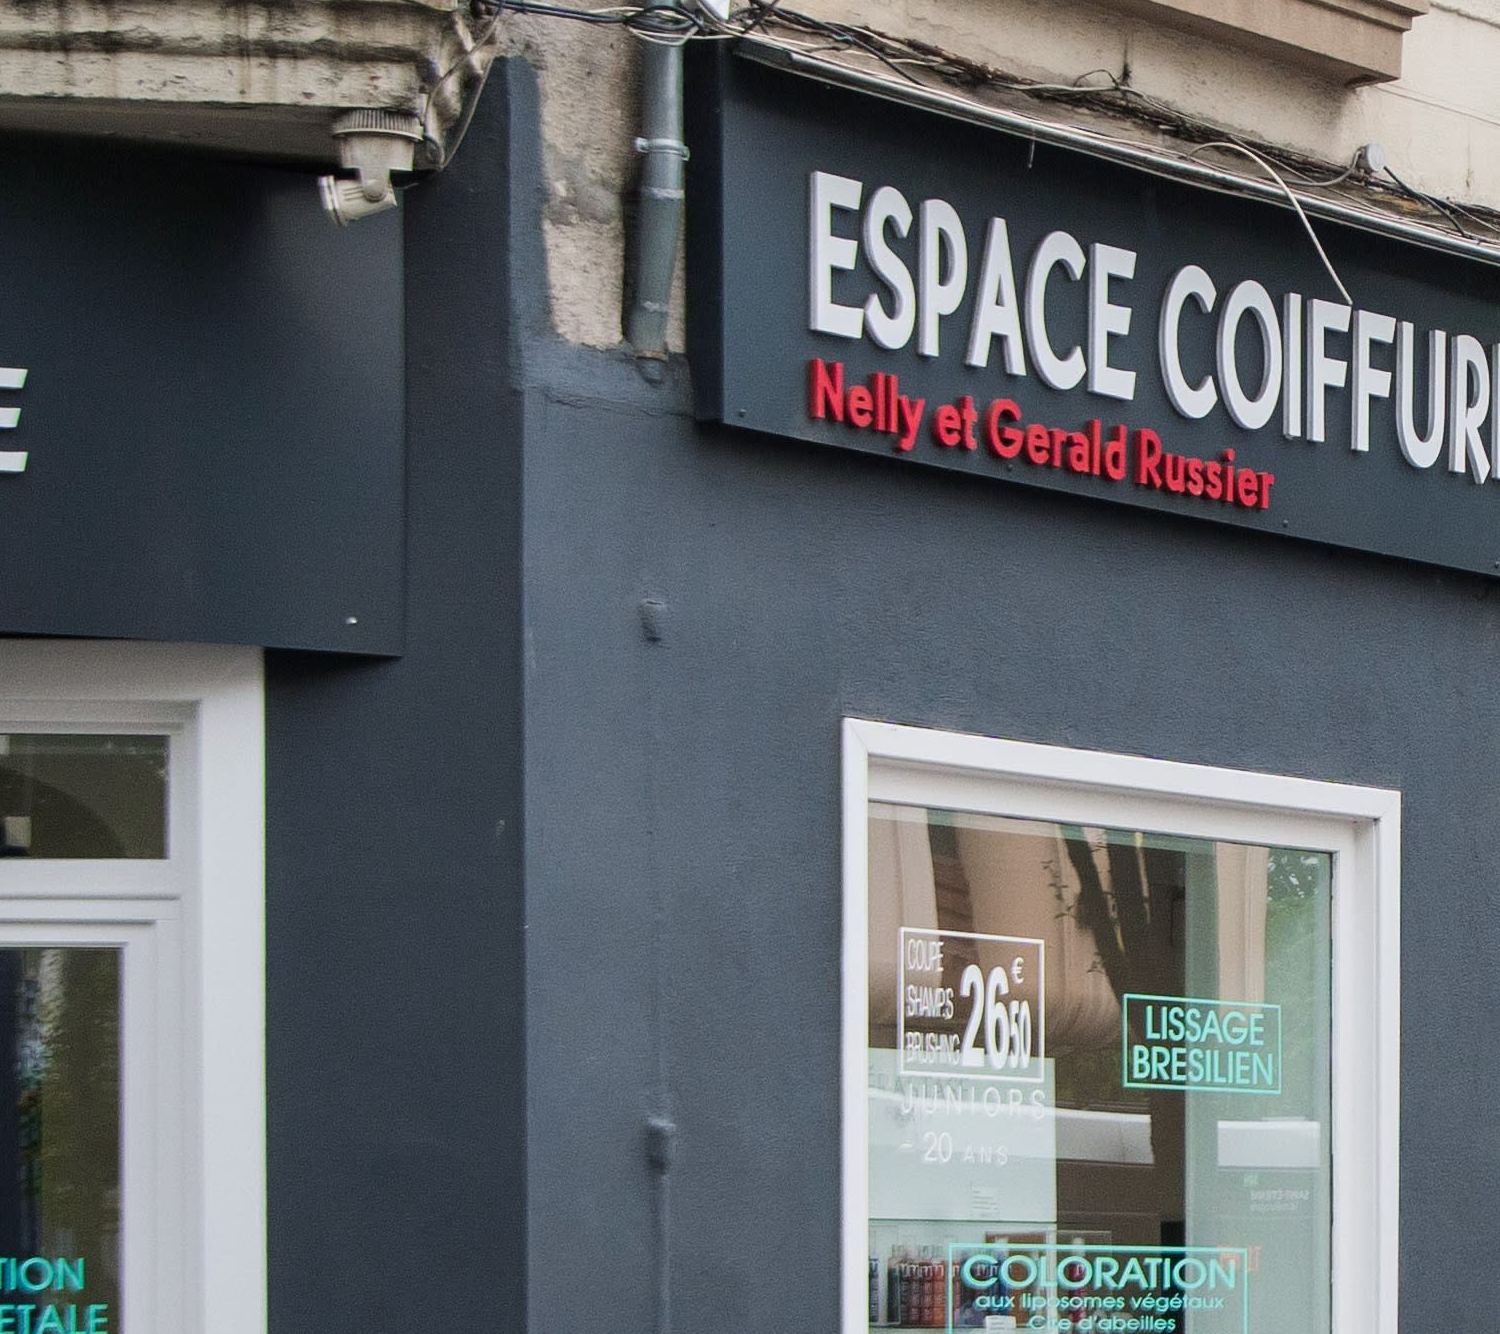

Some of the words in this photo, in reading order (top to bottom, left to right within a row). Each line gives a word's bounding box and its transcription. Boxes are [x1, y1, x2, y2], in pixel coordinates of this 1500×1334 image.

[809, 170, 1137, 401] ESPACE
[808, 357, 925, 452] Nelly
[932, 394, 979, 451] et
[986, 398, 1129, 482] Gerald
[1133, 427, 1276, 511] Russier
[906, 938, 945, 973] COUPE
[1145, 1004, 1265, 1047] LISSAGE
[1132, 1044, 1274, 1086] BRESILIEN
[900, 1083, 1047, 1120] JUNIORS
[923, 1131, 953, 1164] 20
[963, 1145, 1010, 1166] ANS
[960, 1253, 1237, 1291] COLORATION
[975, 1294, 1016, 1309] aux
[1022, 1292, 1126, 1311] liposomes
[1130, 1291, 1225, 1313] végétaux
[1028, 1314, 1073, 1333] Cire
[1078, 1315, 1177, 1334] d'abeilles
